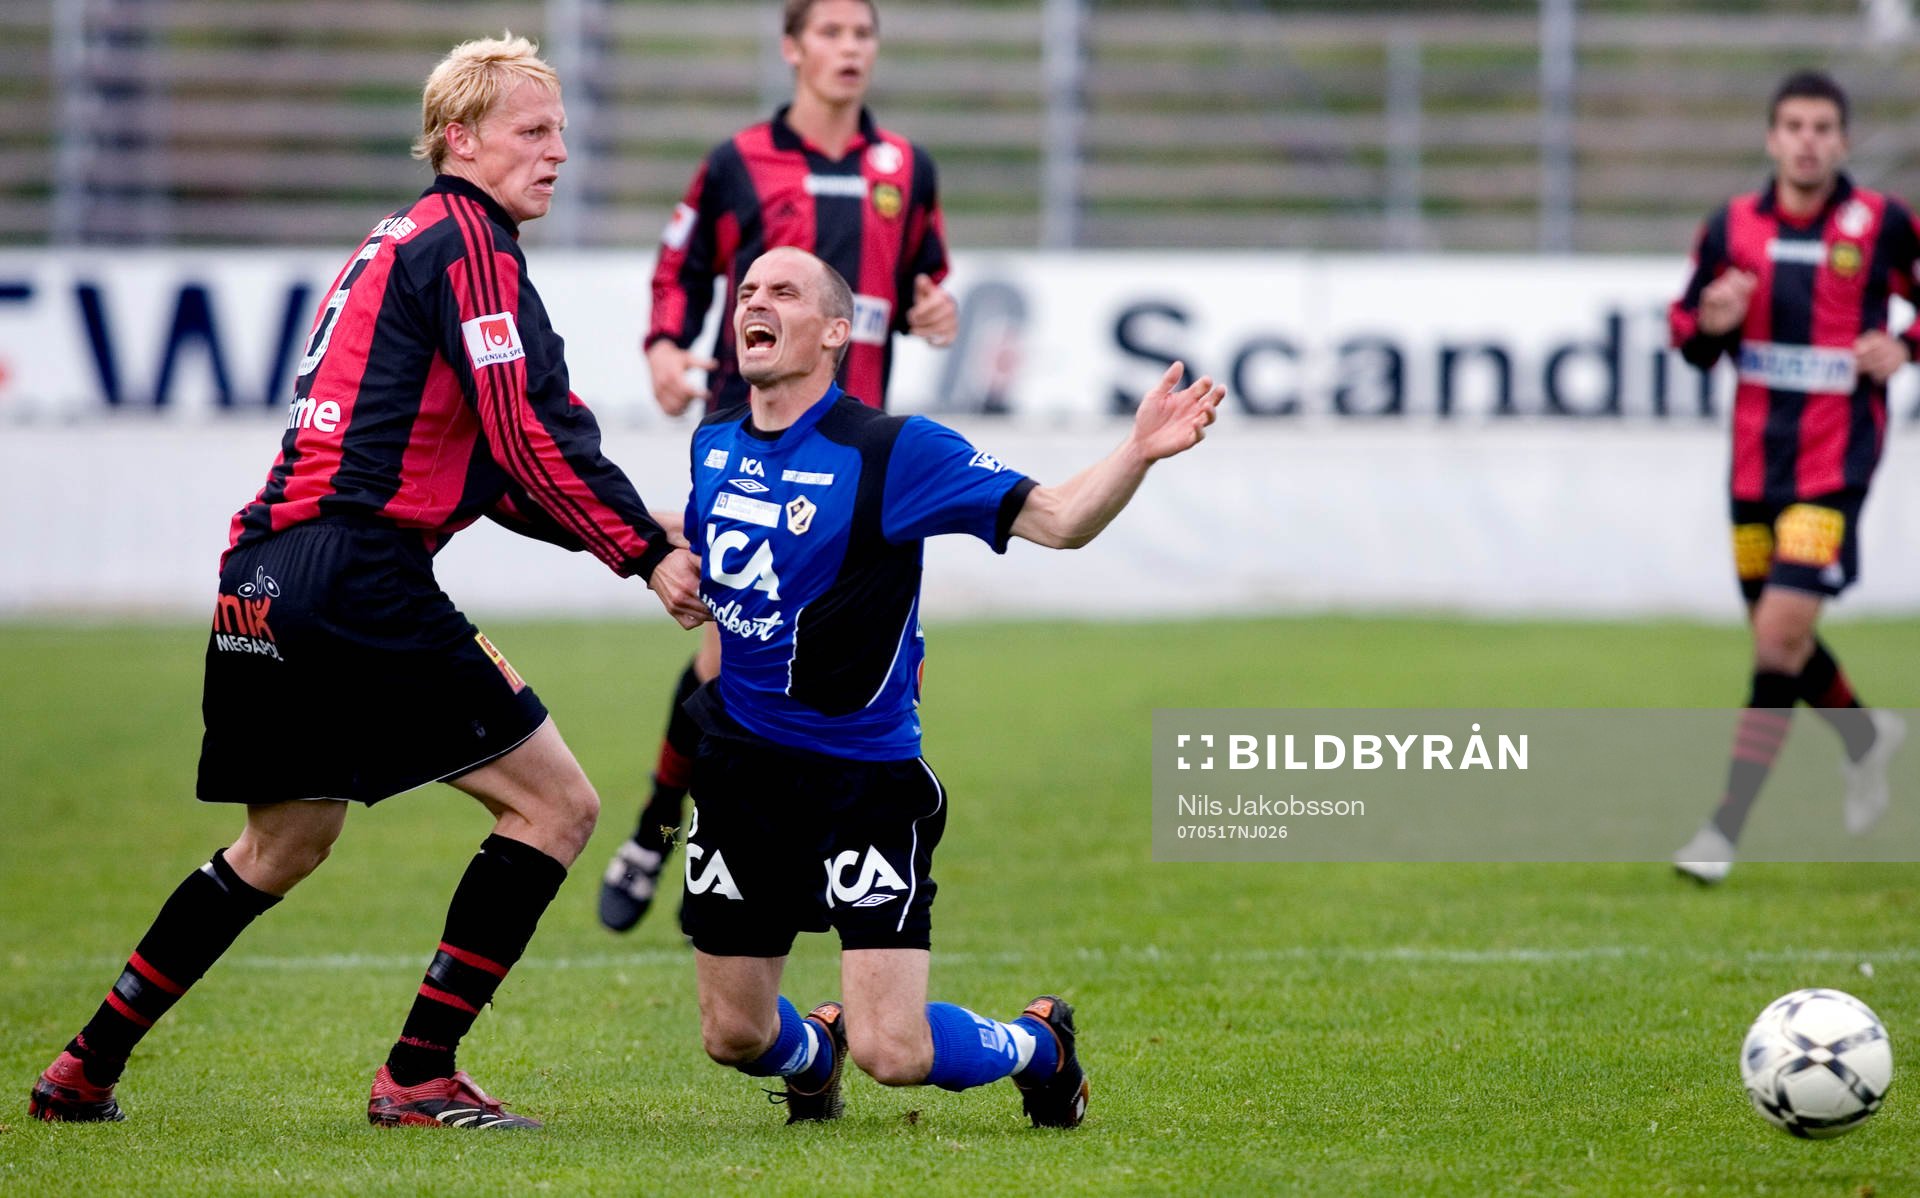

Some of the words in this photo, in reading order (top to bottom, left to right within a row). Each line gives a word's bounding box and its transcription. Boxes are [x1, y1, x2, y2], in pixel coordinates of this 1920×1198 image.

[477, 352, 508, 364] SVENSKA
[739, 457, 764, 477] ICA
[706, 523, 781, 600] ICA
[824, 845, 909, 908] ICA
